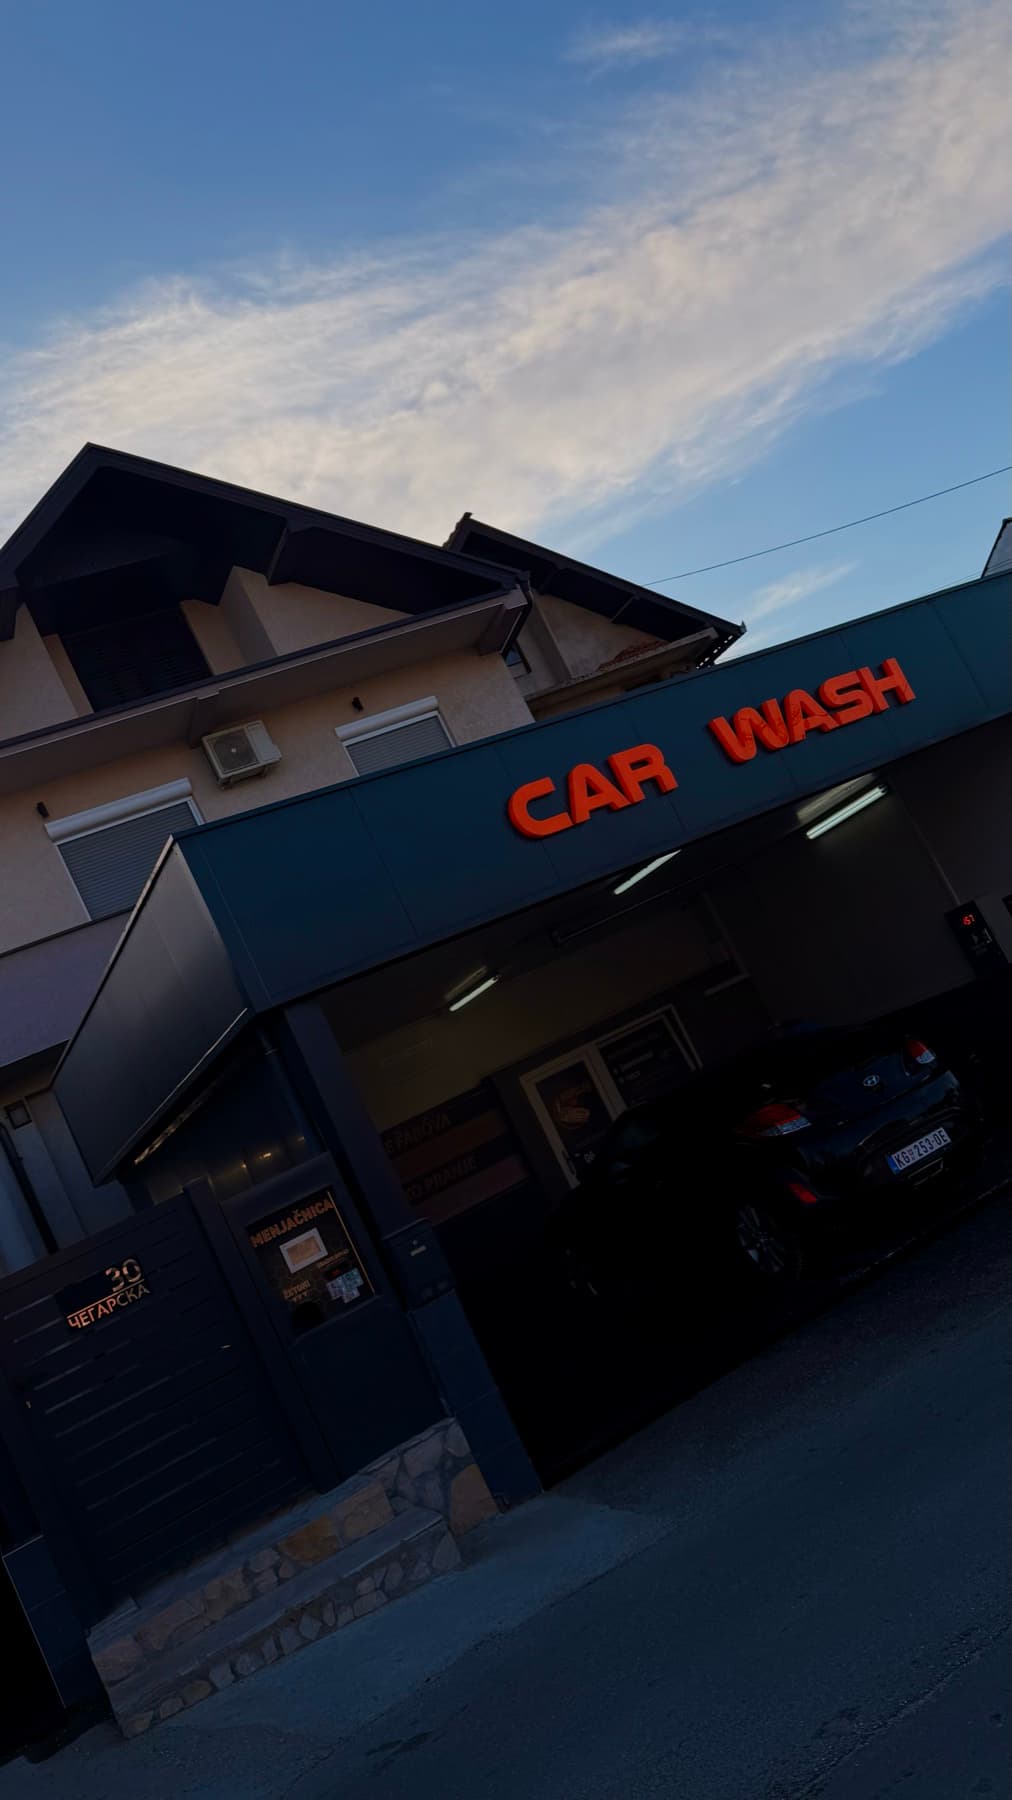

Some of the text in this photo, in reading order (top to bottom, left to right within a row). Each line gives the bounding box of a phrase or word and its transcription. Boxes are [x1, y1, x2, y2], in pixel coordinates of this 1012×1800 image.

[507, 657, 916, 839] CAR WASH
[249, 1196, 334, 1248] MENJAČNICA
[104, 1257, 143, 1292] 30
[66, 1283, 151, 1329] ЧЕГАРСКА
